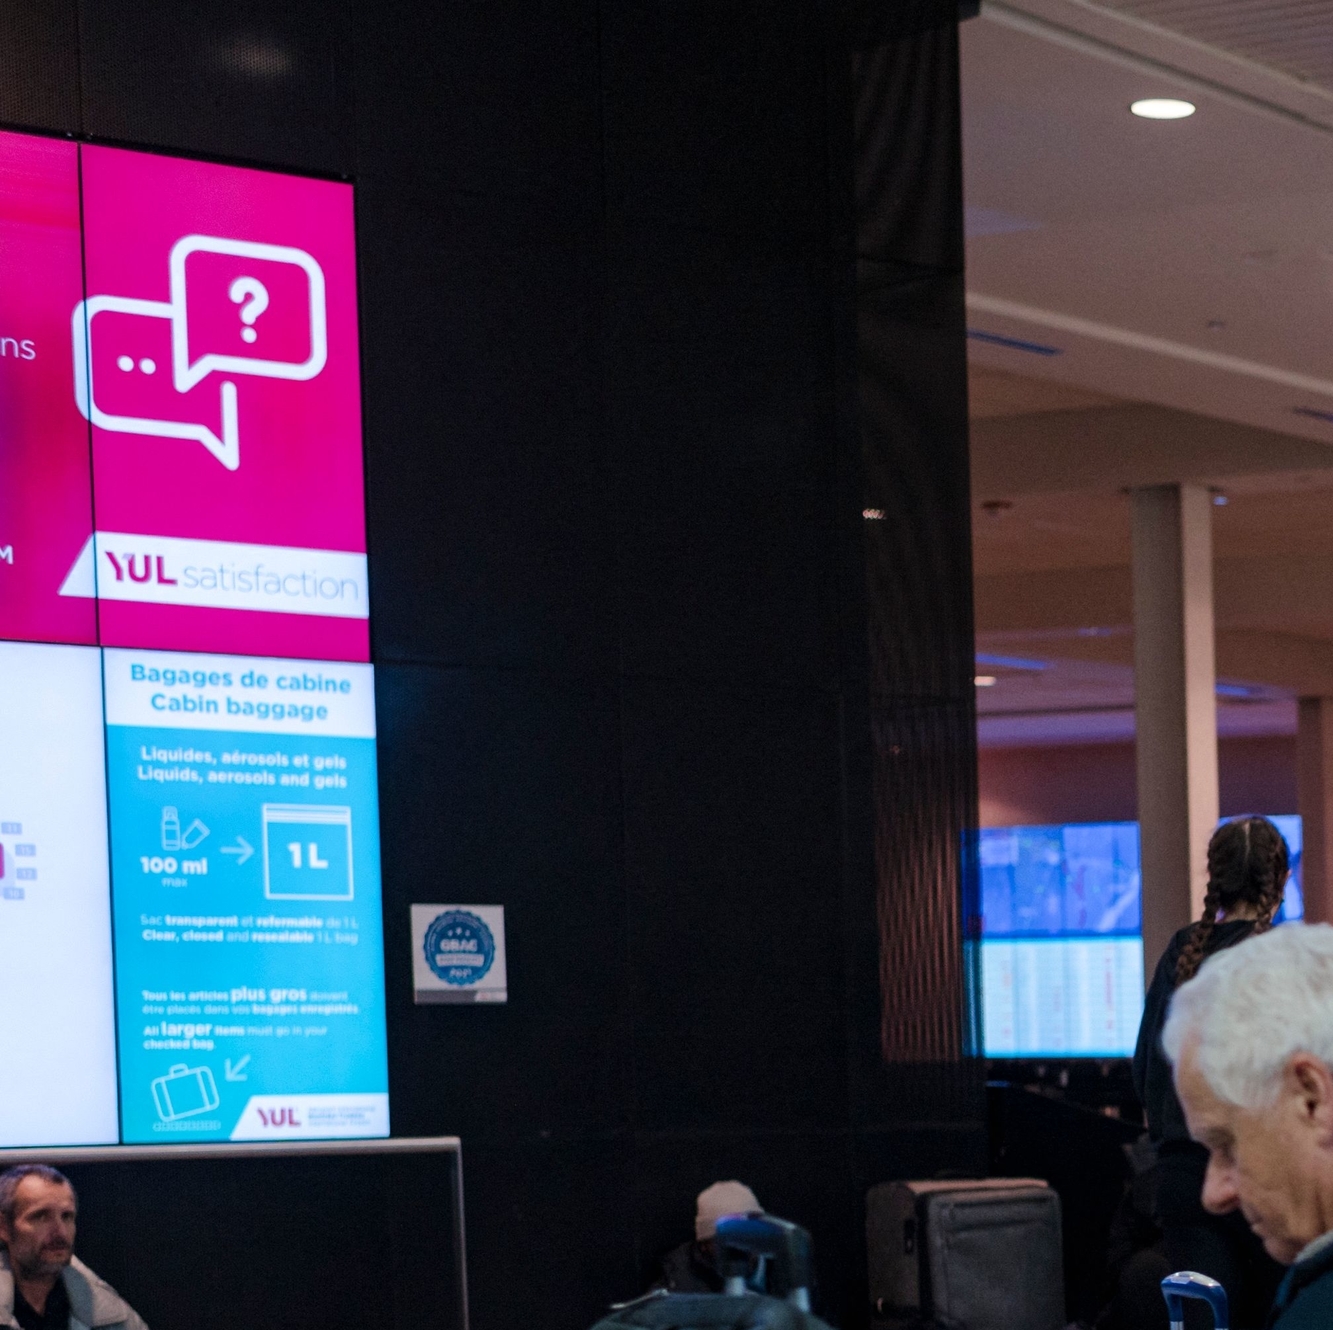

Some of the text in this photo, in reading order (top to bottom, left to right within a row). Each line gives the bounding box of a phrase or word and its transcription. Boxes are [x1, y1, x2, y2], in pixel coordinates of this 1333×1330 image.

[105, 550, 359, 601] YUL satisfaction
[130, 663, 351, 694] Bagages de cabine
[151, 693, 328, 722] Cabin baggage
[141, 746, 347, 771] Liquides, aérosols et gels
[137, 765, 347, 790] Liquids, aerosols and gels
[140, 856, 208, 875] 100 ml
[162, 877, 188, 888] max
[142, 929, 180, 943] Clear,
[181, 929, 224, 942] closed
[230, 985, 266, 1004] plus
[270, 988, 308, 1004] gros
[161, 1020, 213, 1039] larger
[257, 1106, 302, 1129] YUL
